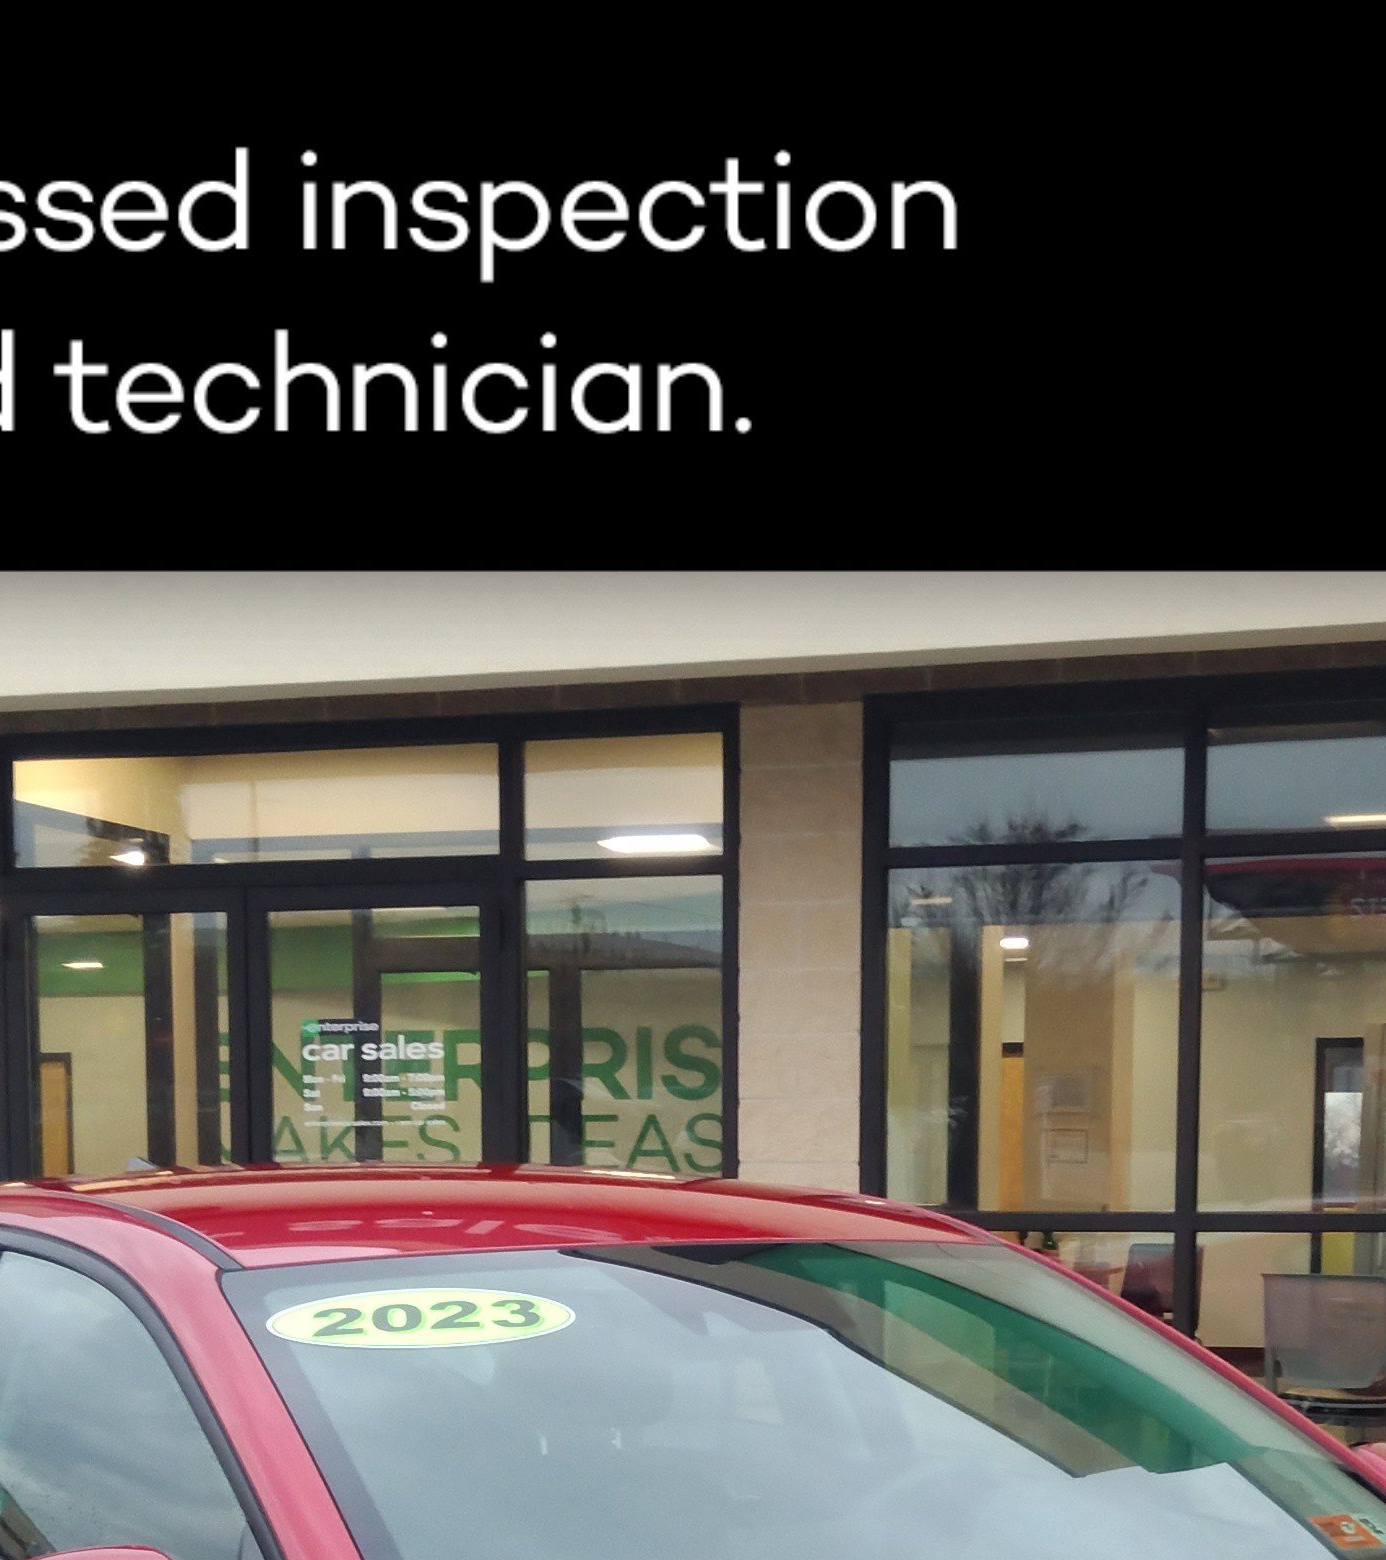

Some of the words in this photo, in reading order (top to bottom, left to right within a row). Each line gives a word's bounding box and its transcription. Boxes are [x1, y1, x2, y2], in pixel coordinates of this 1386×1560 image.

[305, 1021, 380, 1035] enterprise
[302, 1043, 355, 1062] car
[360, 1035, 445, 1061] sales
[312, 1299, 543, 1338] 2023
